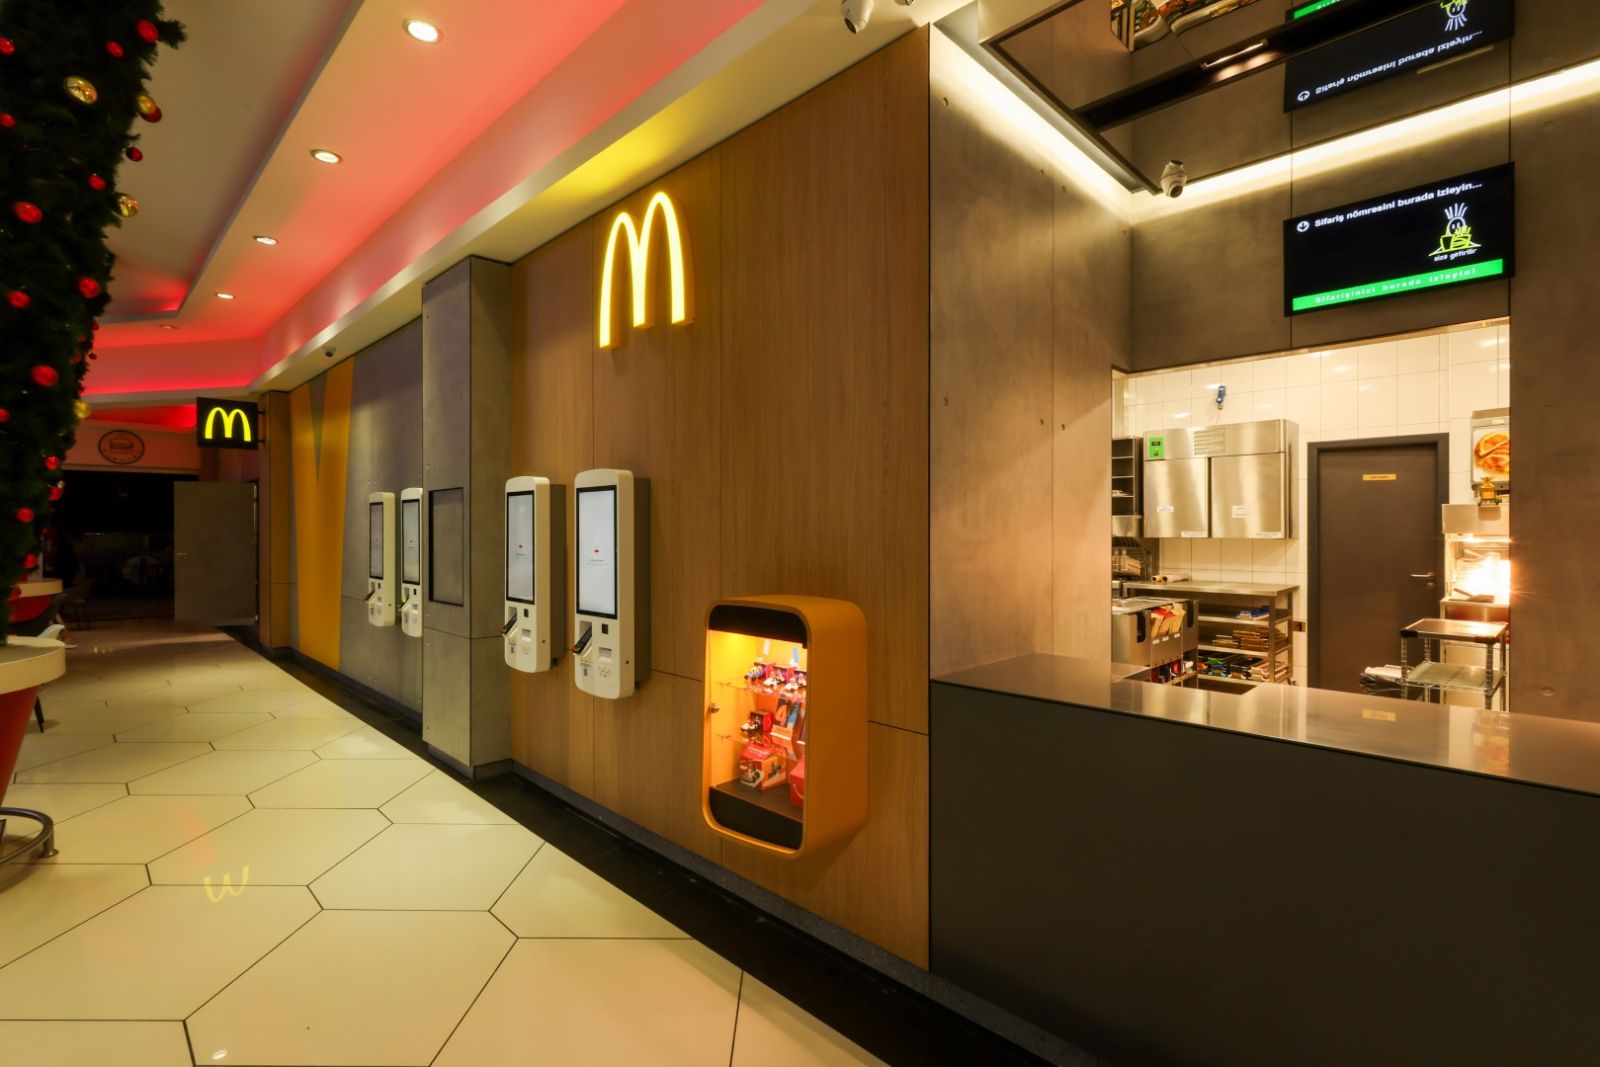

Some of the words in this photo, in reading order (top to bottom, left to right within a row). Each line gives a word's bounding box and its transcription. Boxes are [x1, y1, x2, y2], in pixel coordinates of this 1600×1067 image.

[1314, 215, 1345, 229] Sifariş
[1397, 190, 1435, 208] burada
[1382, 278, 1422, 291] burada
[204, 406, 252, 442] M
